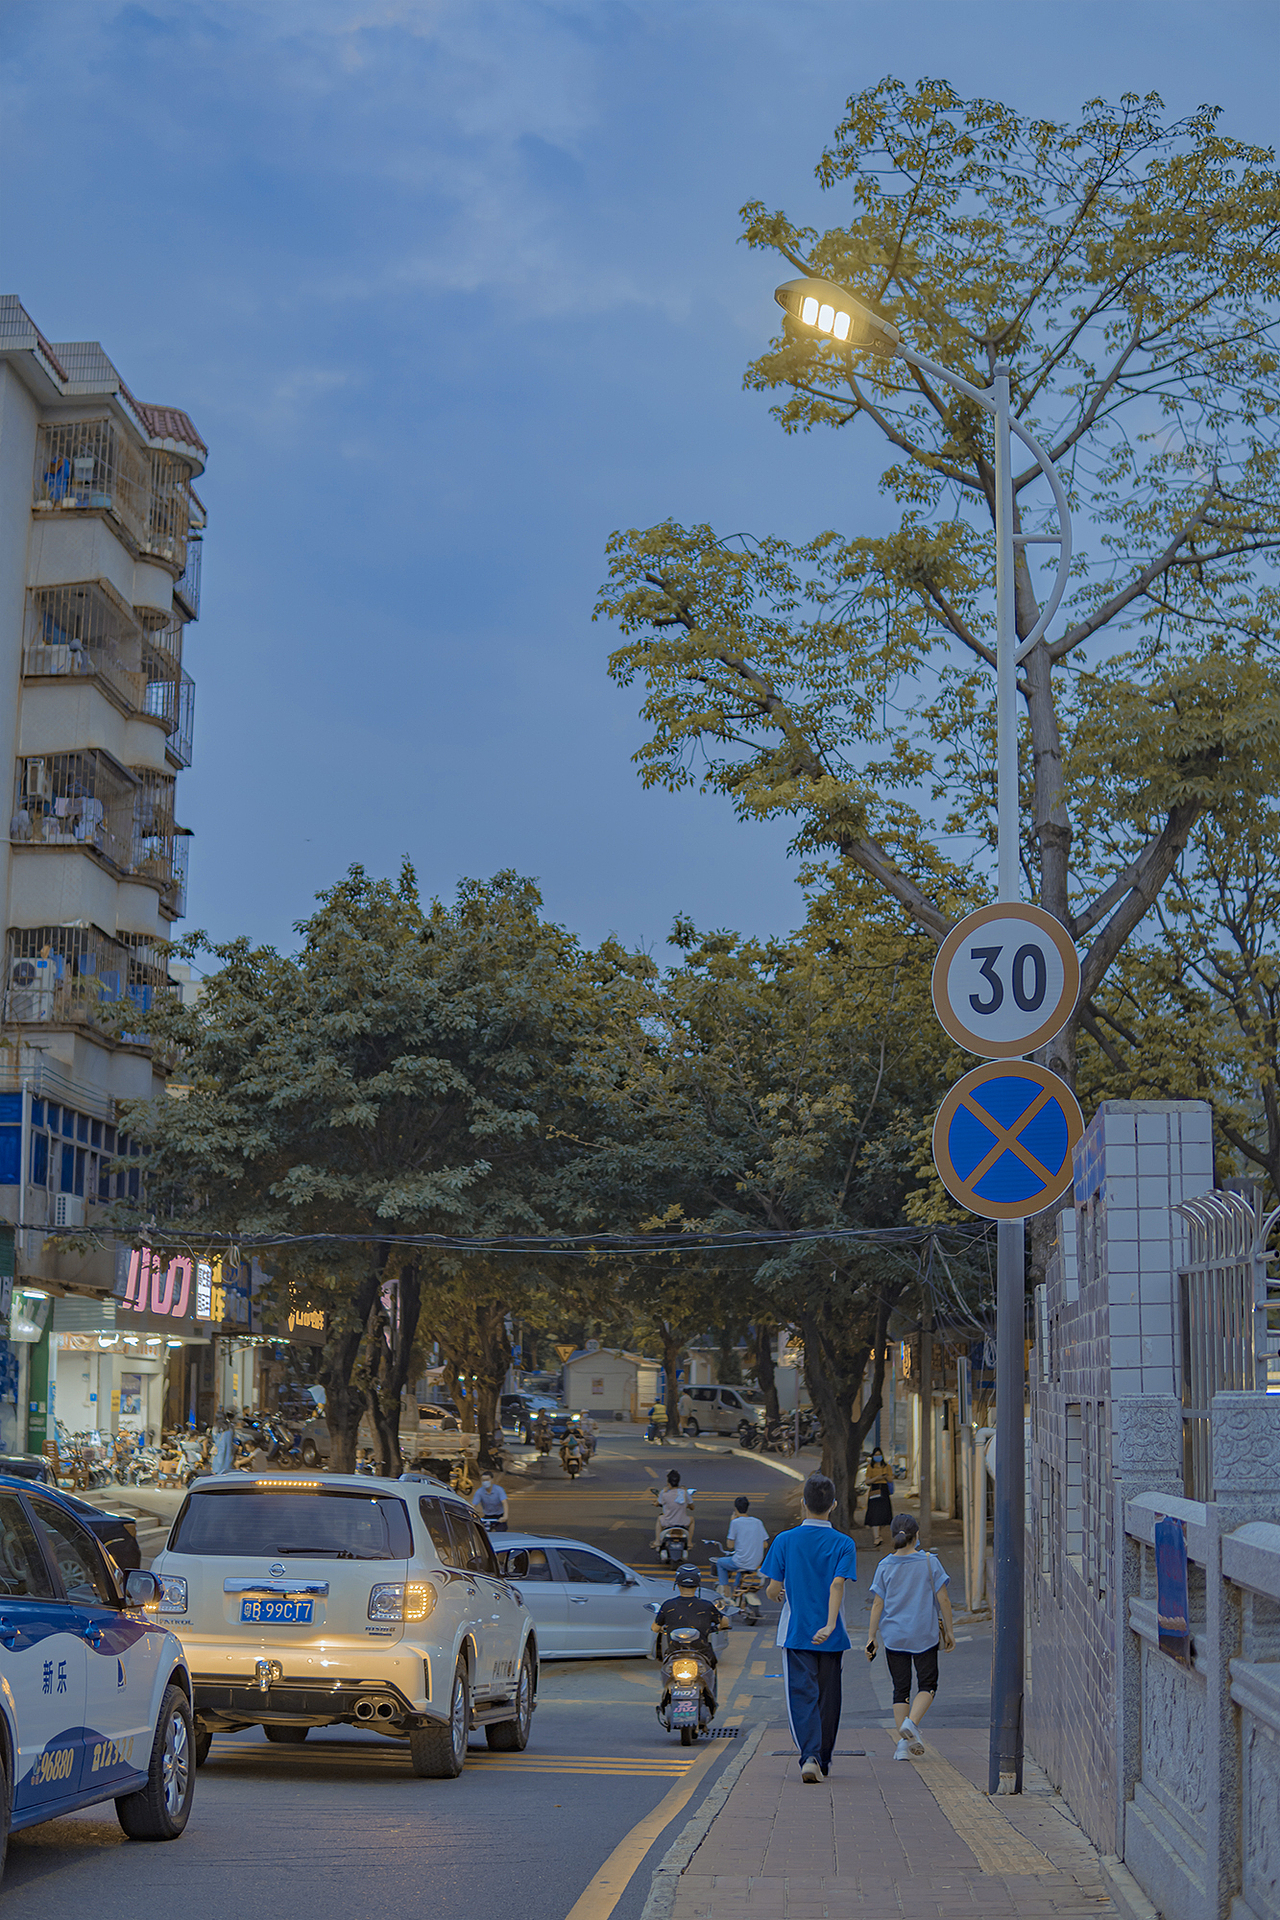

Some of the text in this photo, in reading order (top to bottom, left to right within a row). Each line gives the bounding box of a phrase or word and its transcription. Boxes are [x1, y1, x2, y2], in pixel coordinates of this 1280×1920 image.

[969, 943, 1047, 1015] 30
[42, 1660, 67, 1694] 新乐
[39, 1748, 75, 1784] 96880
[100, 1736, 134, 1768] 12328
